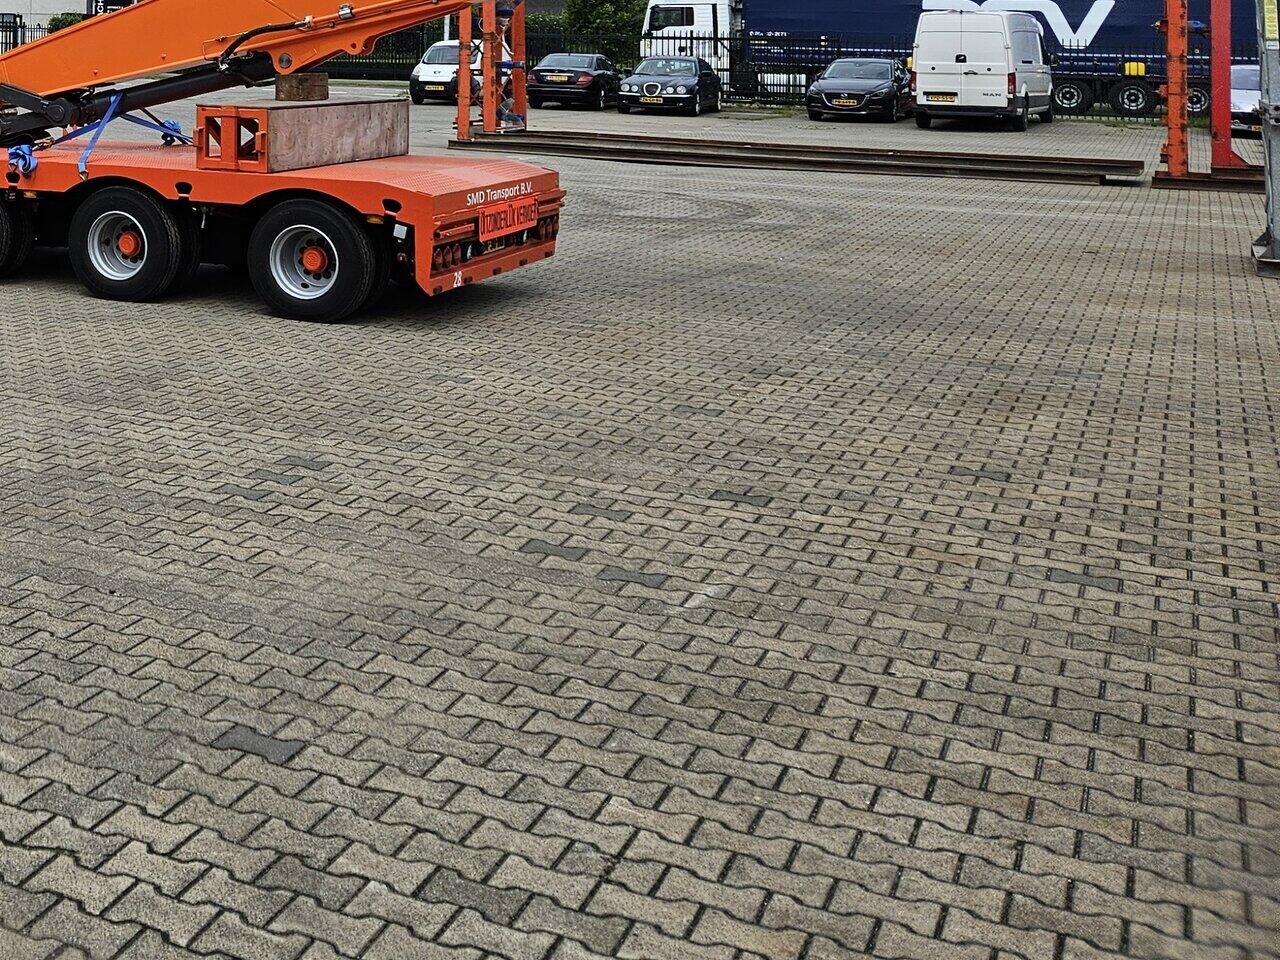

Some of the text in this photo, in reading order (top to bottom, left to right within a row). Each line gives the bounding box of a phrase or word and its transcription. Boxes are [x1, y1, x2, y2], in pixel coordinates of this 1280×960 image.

[467, 181, 533, 206] SMD Transport B.V.
[453, 270, 462, 288] 28
